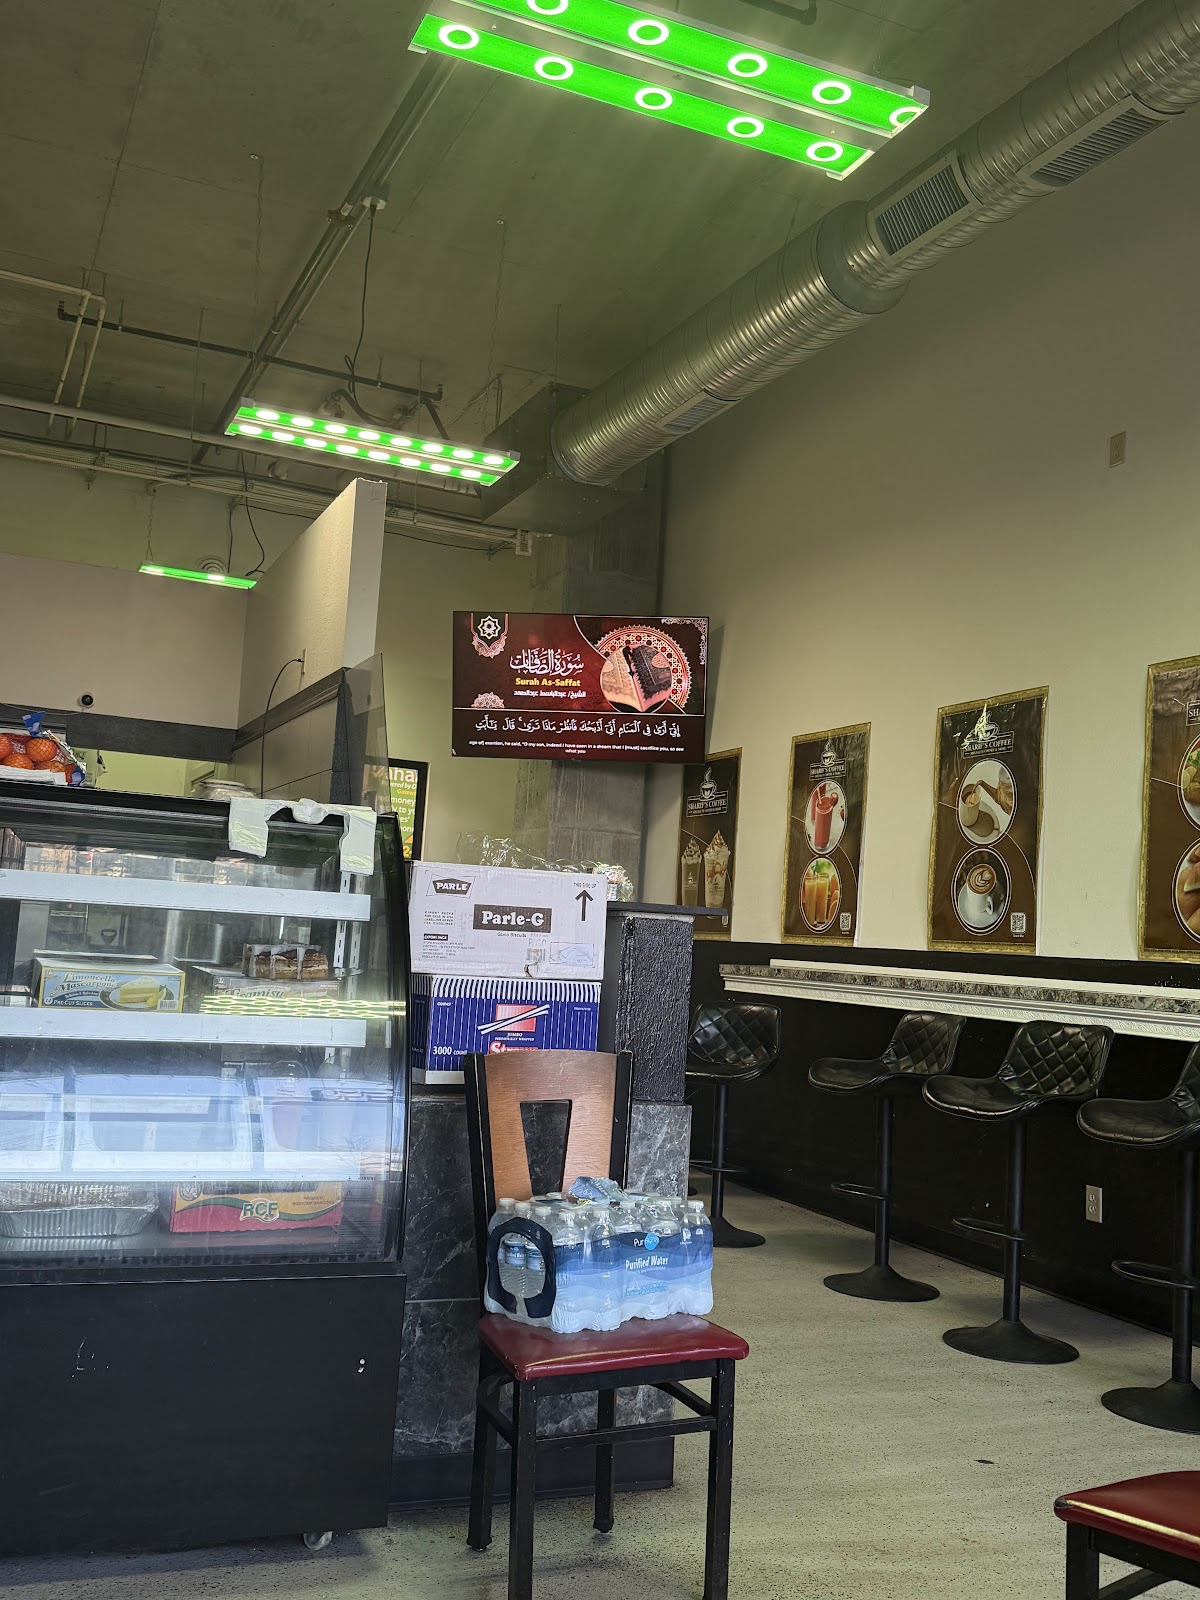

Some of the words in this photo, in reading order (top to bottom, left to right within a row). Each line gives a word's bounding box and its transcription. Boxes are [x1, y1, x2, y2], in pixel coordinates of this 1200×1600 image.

[515, 678, 540, 686] Surah
[541, 678, 581, 687] As-Saffat
[989, 739, 1012, 748] COFFEE
[391, 797, 416, 807] money
[708, 799, 727, 807] COFFEE
[436, 882, 468, 891] PARLE
[481, 910, 544, 927] Parle-G
[62, 972, 116, 983] Limoncello
[59, 981, 117, 992] Mascarpone
[433, 1046, 453, 1055] 3000
[243, 1202, 279, 1217] RCF
[626, 1256, 650, 1270] Purified
[651, 1255, 669, 1266] Water
